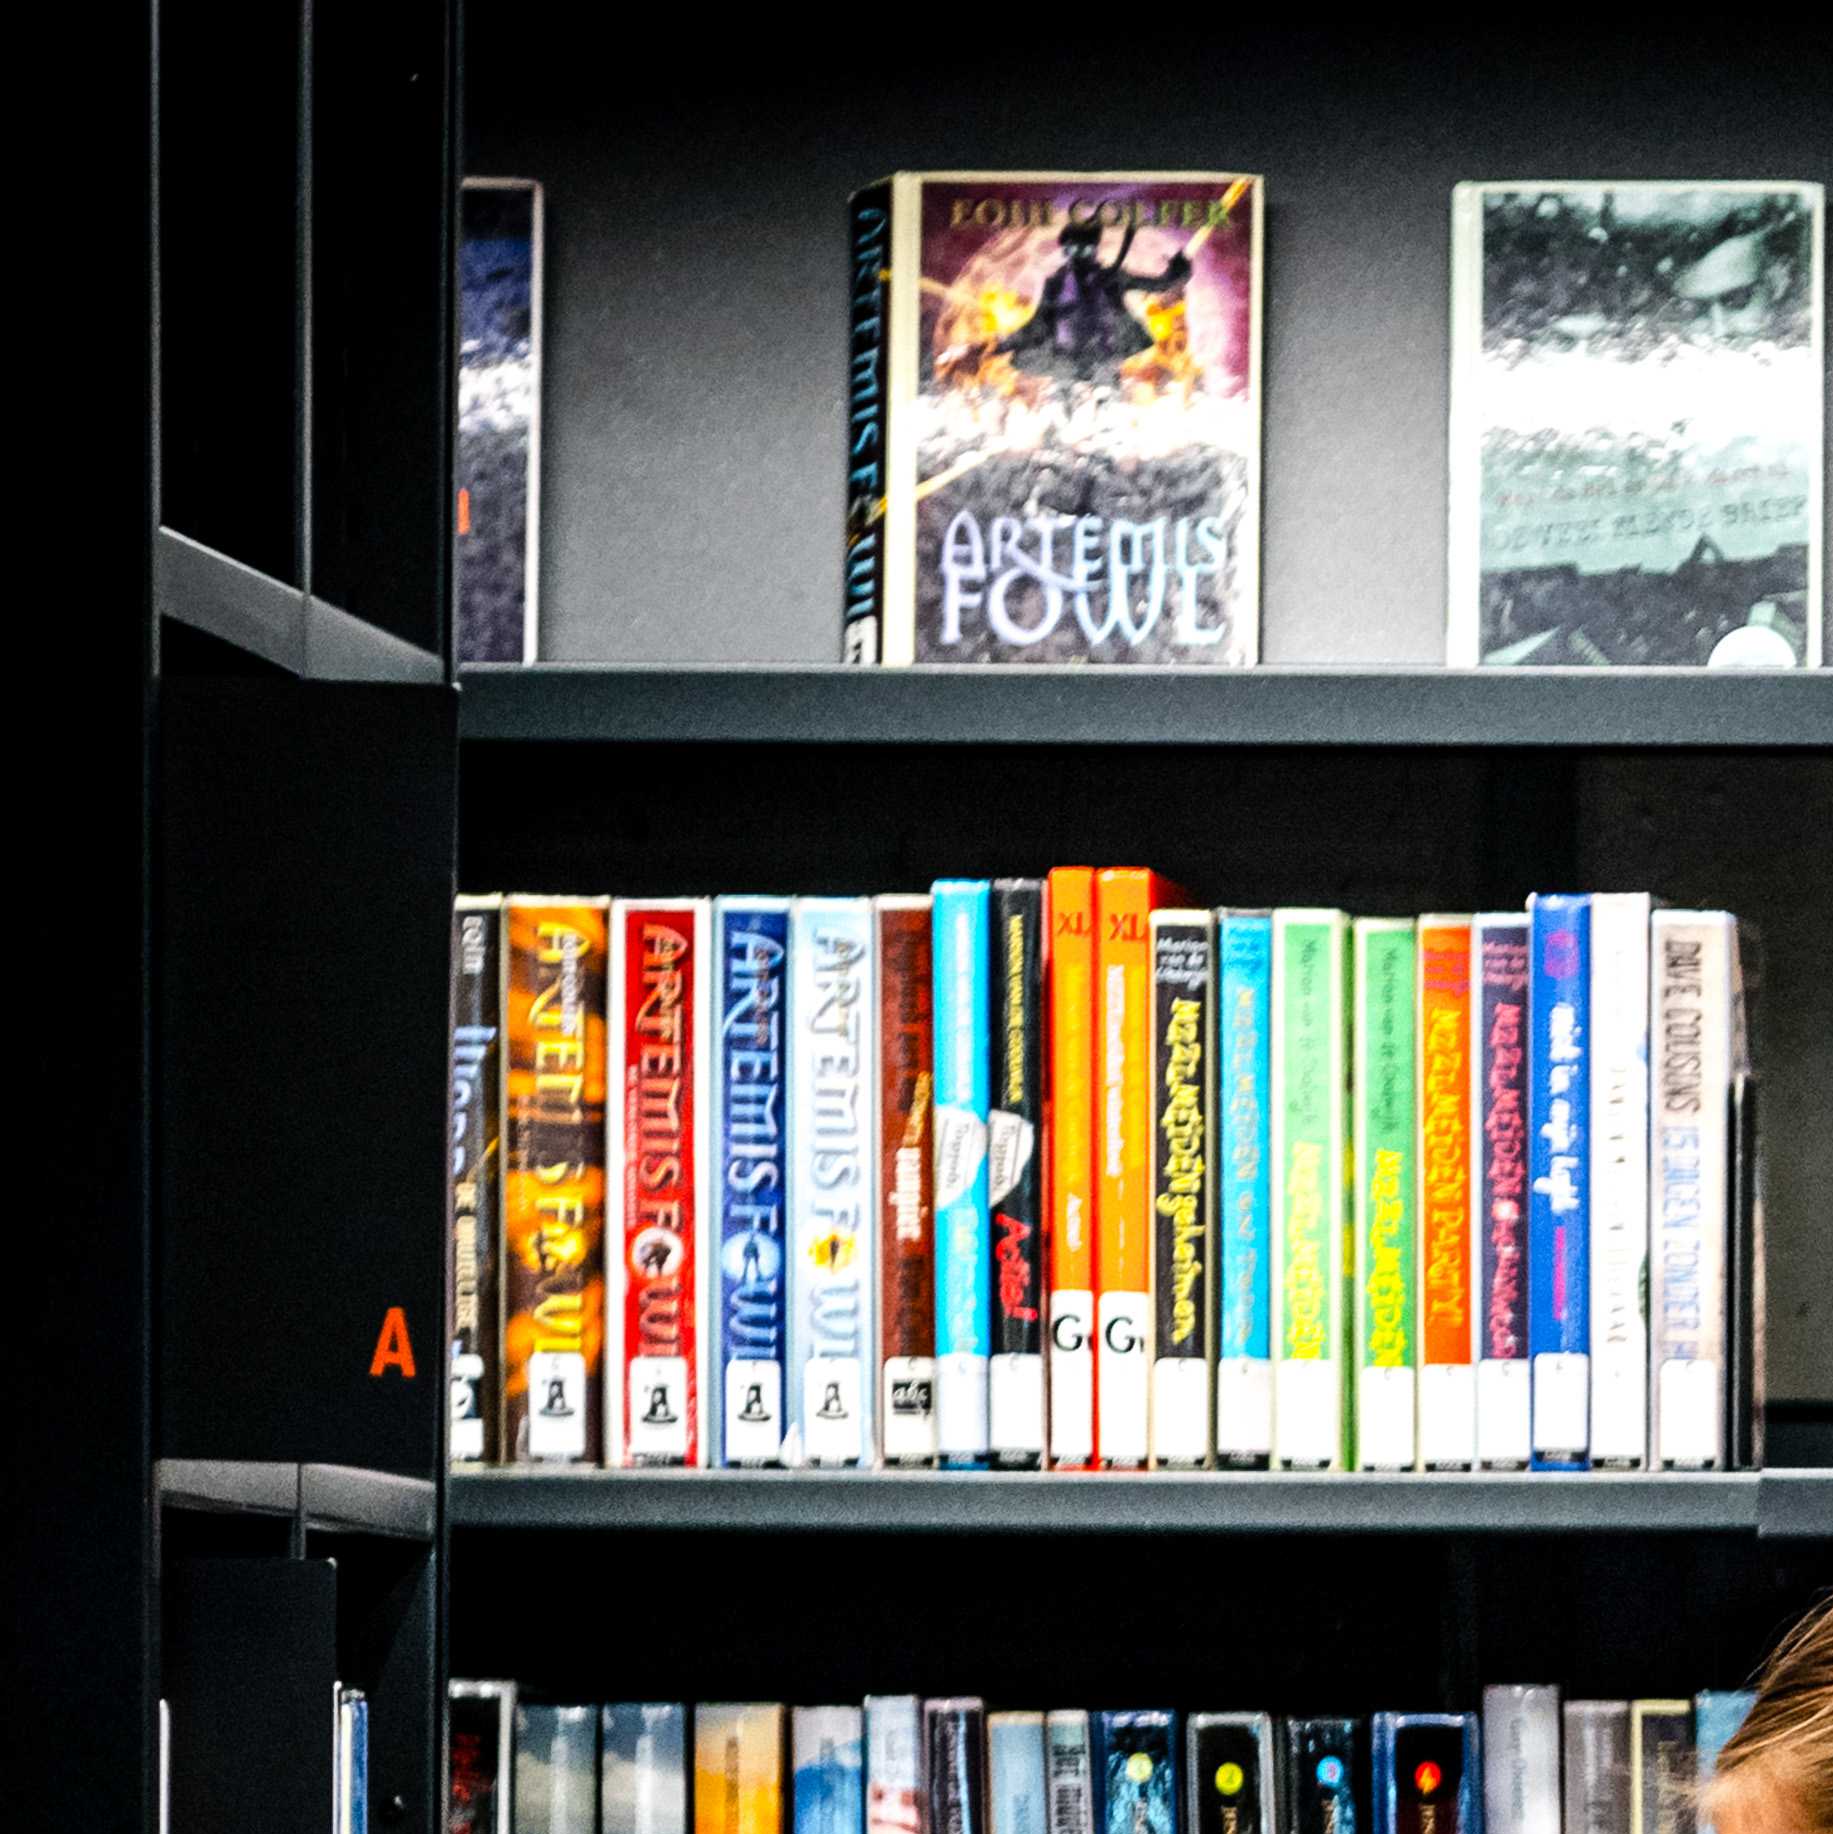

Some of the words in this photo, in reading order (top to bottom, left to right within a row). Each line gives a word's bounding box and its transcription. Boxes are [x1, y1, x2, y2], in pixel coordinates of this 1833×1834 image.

[941, 509, 1227, 580] ARTEMIS
[941, 563, 1225, 647] FOWL
[1664, 939, 1702, 1000] DAVE
[635, 923, 688, 1190] ARTEMIS
[722, 930, 784, 1194] ARTEMIS
[810, 927, 866, 1184] ARTEMIS
[995, 1213, 1039, 1322] Actie!
[370, 1306, 417, 1378] A
